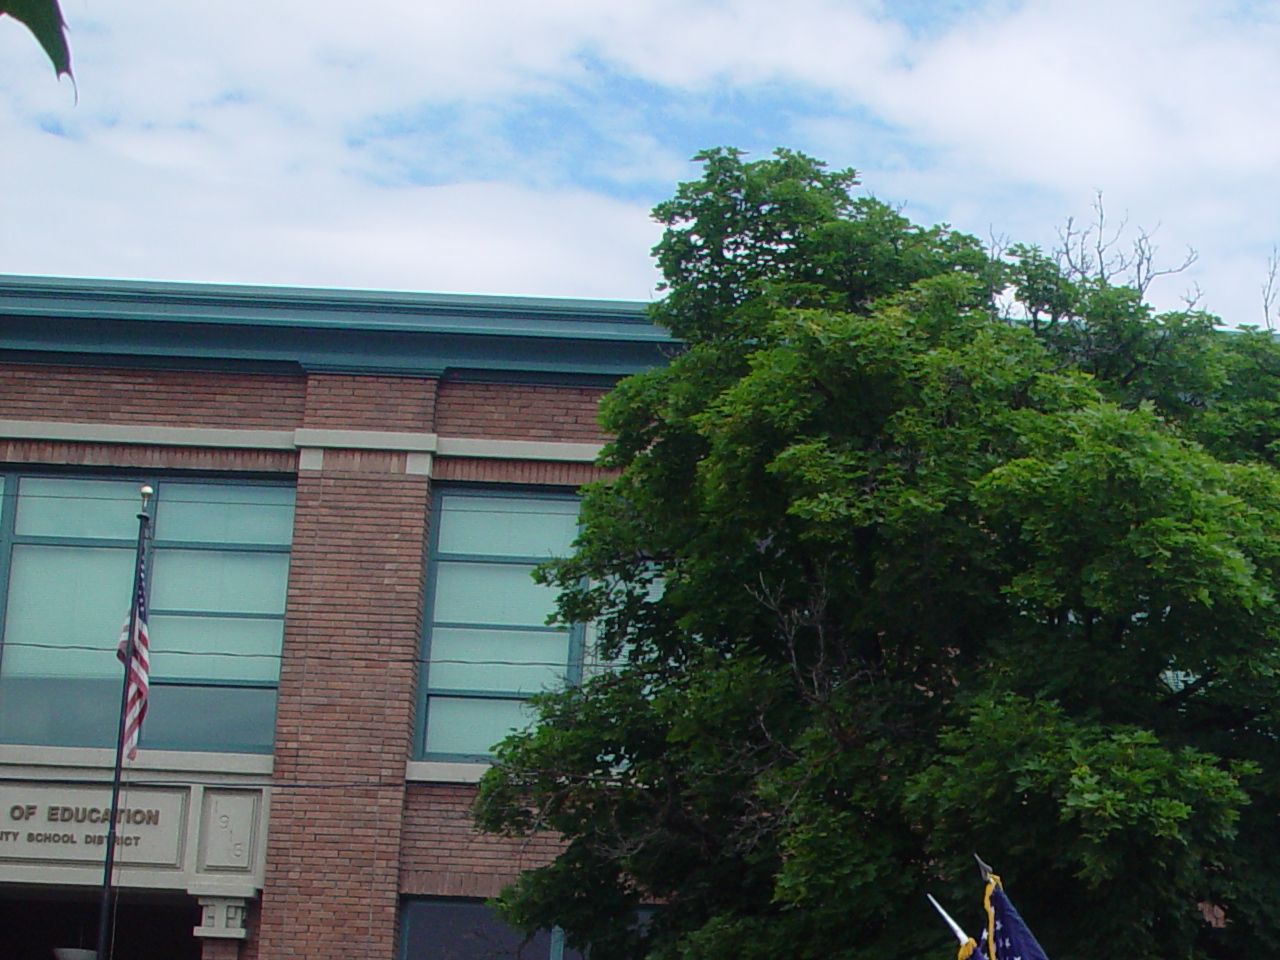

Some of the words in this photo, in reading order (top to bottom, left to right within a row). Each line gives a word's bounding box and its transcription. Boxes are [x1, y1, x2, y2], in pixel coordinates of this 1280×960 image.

[10, 805, 37, 821] OF
[47, 806, 160, 825] EDUCATION
[26, 832, 77, 844] SCHOOL
[84, 834, 141, 846] DISRICT
